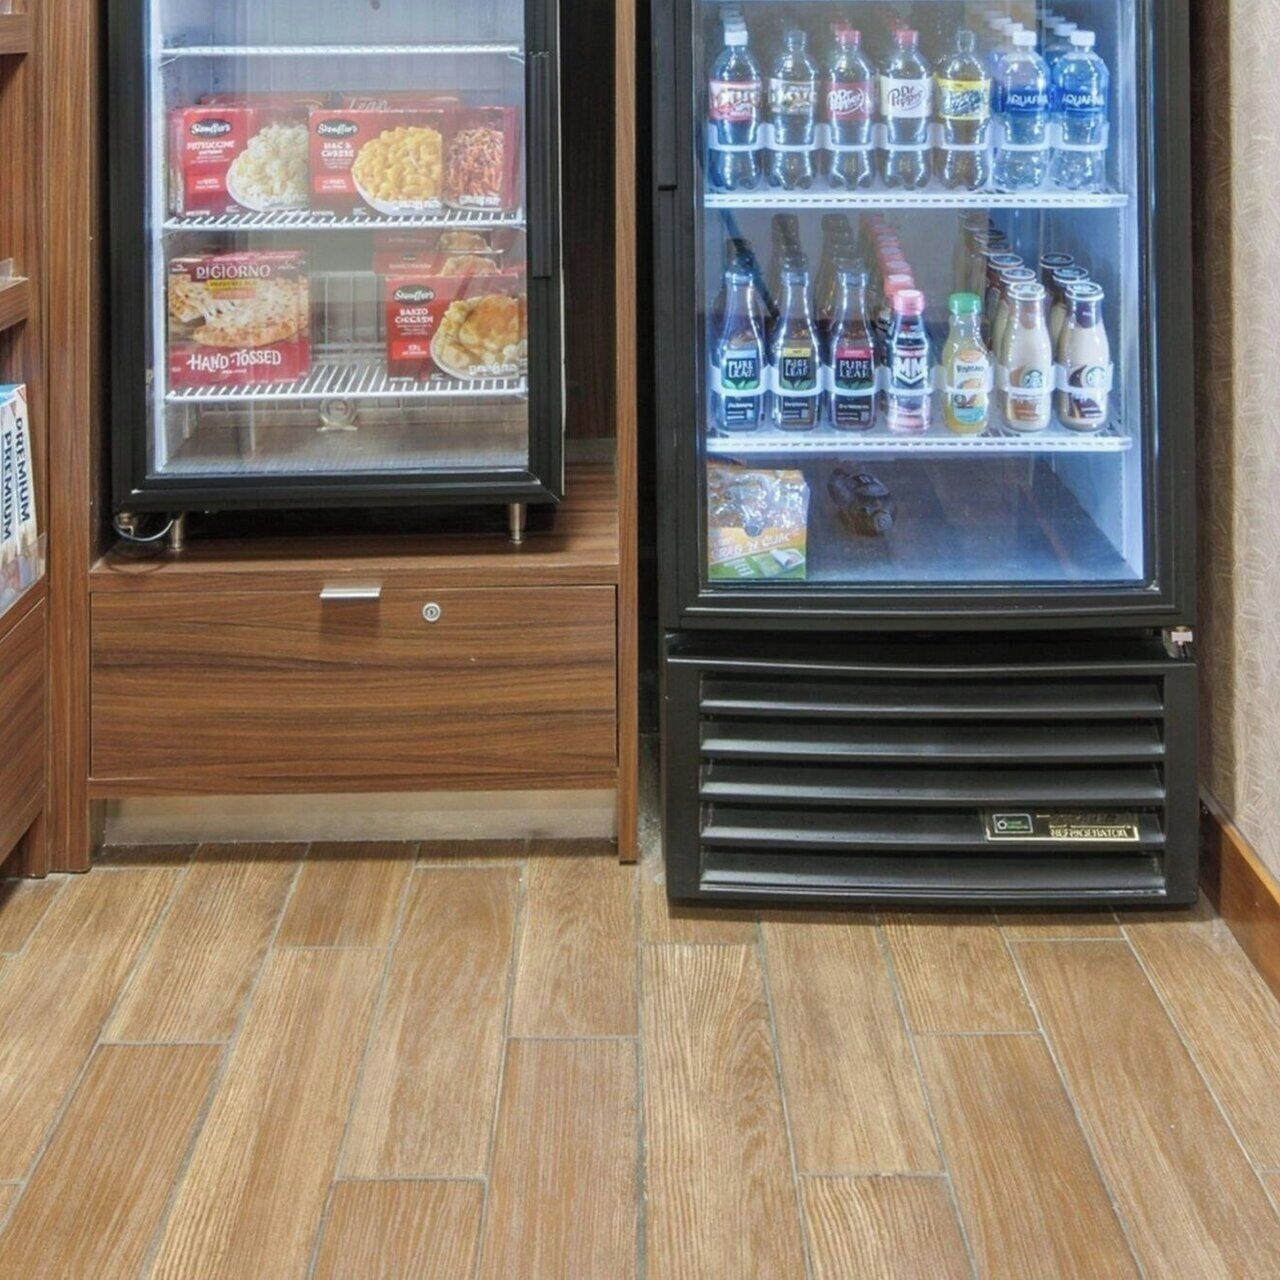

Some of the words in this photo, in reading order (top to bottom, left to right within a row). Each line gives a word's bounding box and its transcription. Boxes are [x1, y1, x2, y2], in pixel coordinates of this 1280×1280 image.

[839, 360, 869, 369] PURE
[839, 369, 869, 379] LEAF
[15, 416, 31, 522] PREMIUM
